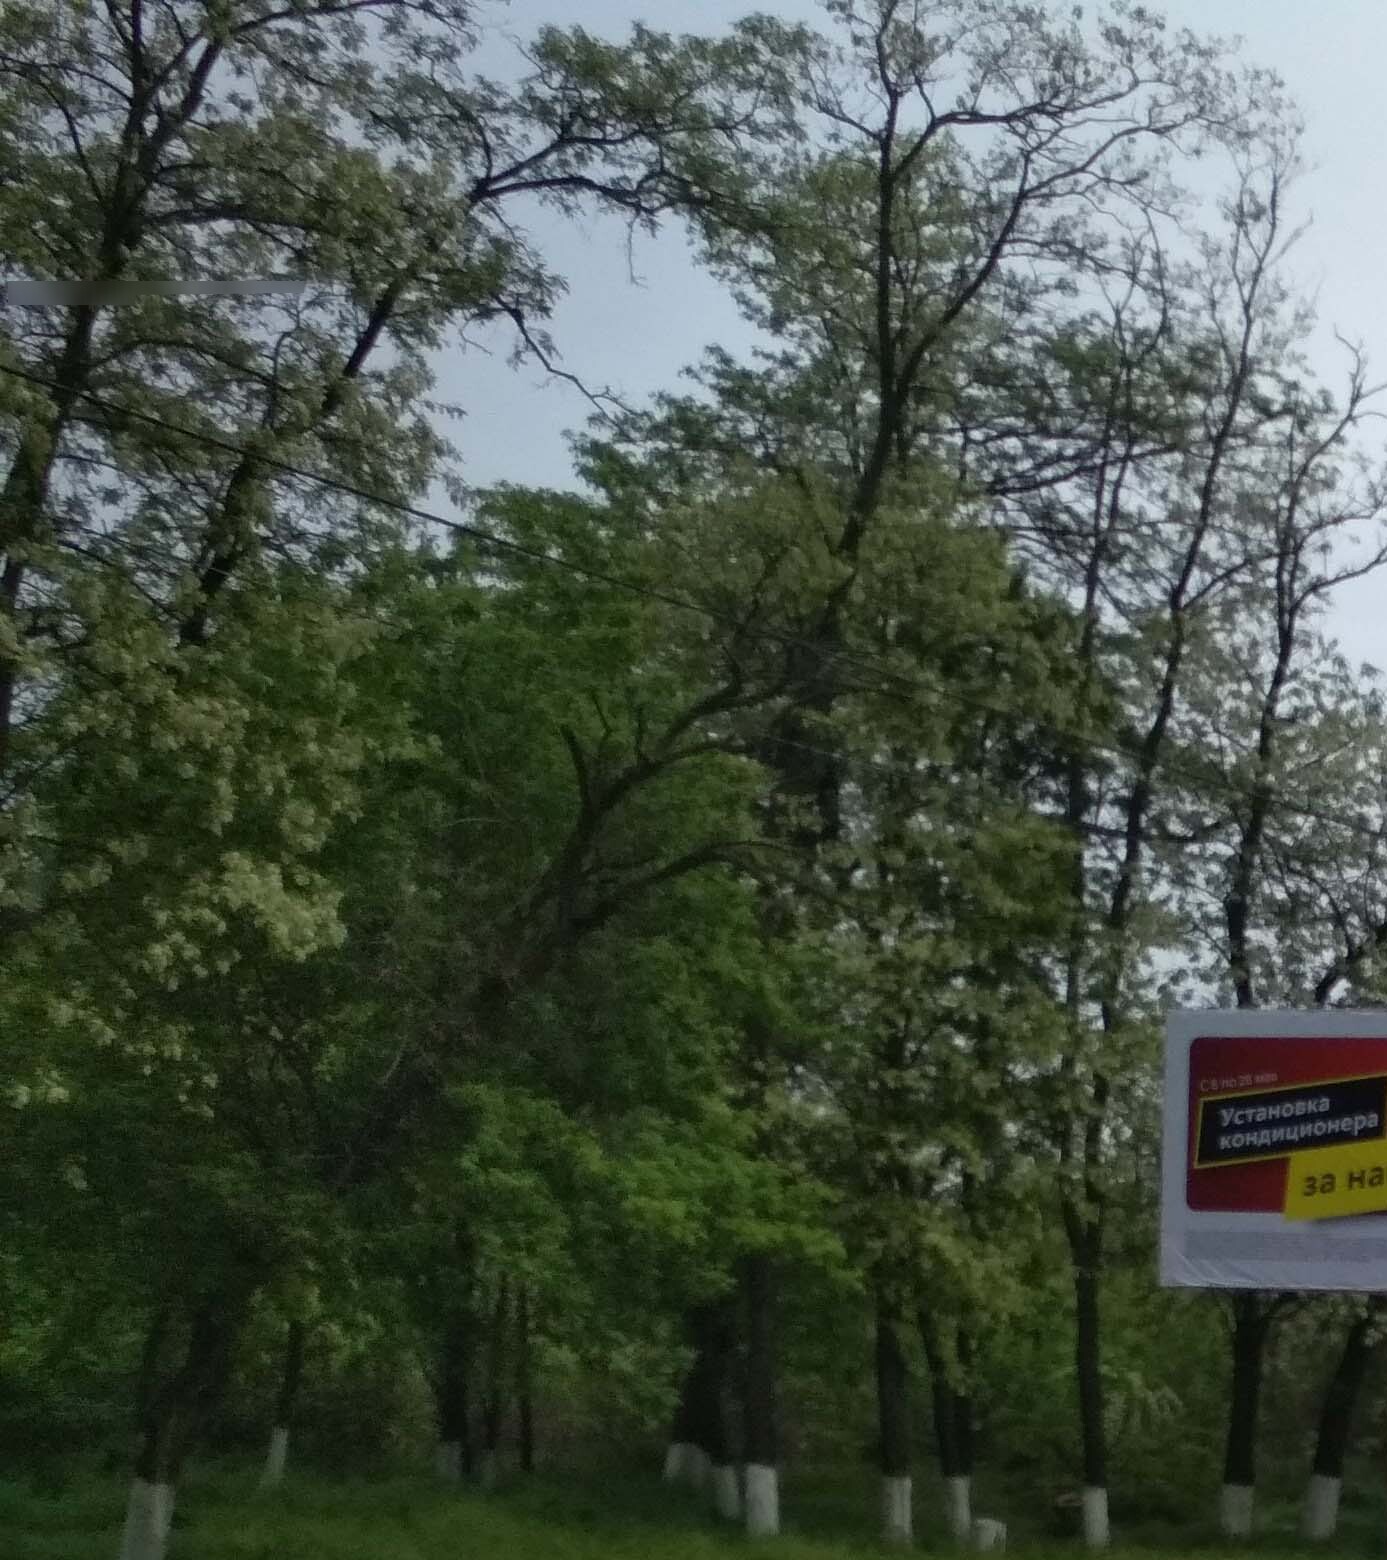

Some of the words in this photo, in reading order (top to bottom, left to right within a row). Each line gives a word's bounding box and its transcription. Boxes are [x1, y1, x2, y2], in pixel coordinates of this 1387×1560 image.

[1219, 1096, 1331, 1127] Установка
[1218, 1112, 1380, 1150] кондиционера
[1303, 1172, 1337, 1197] за
